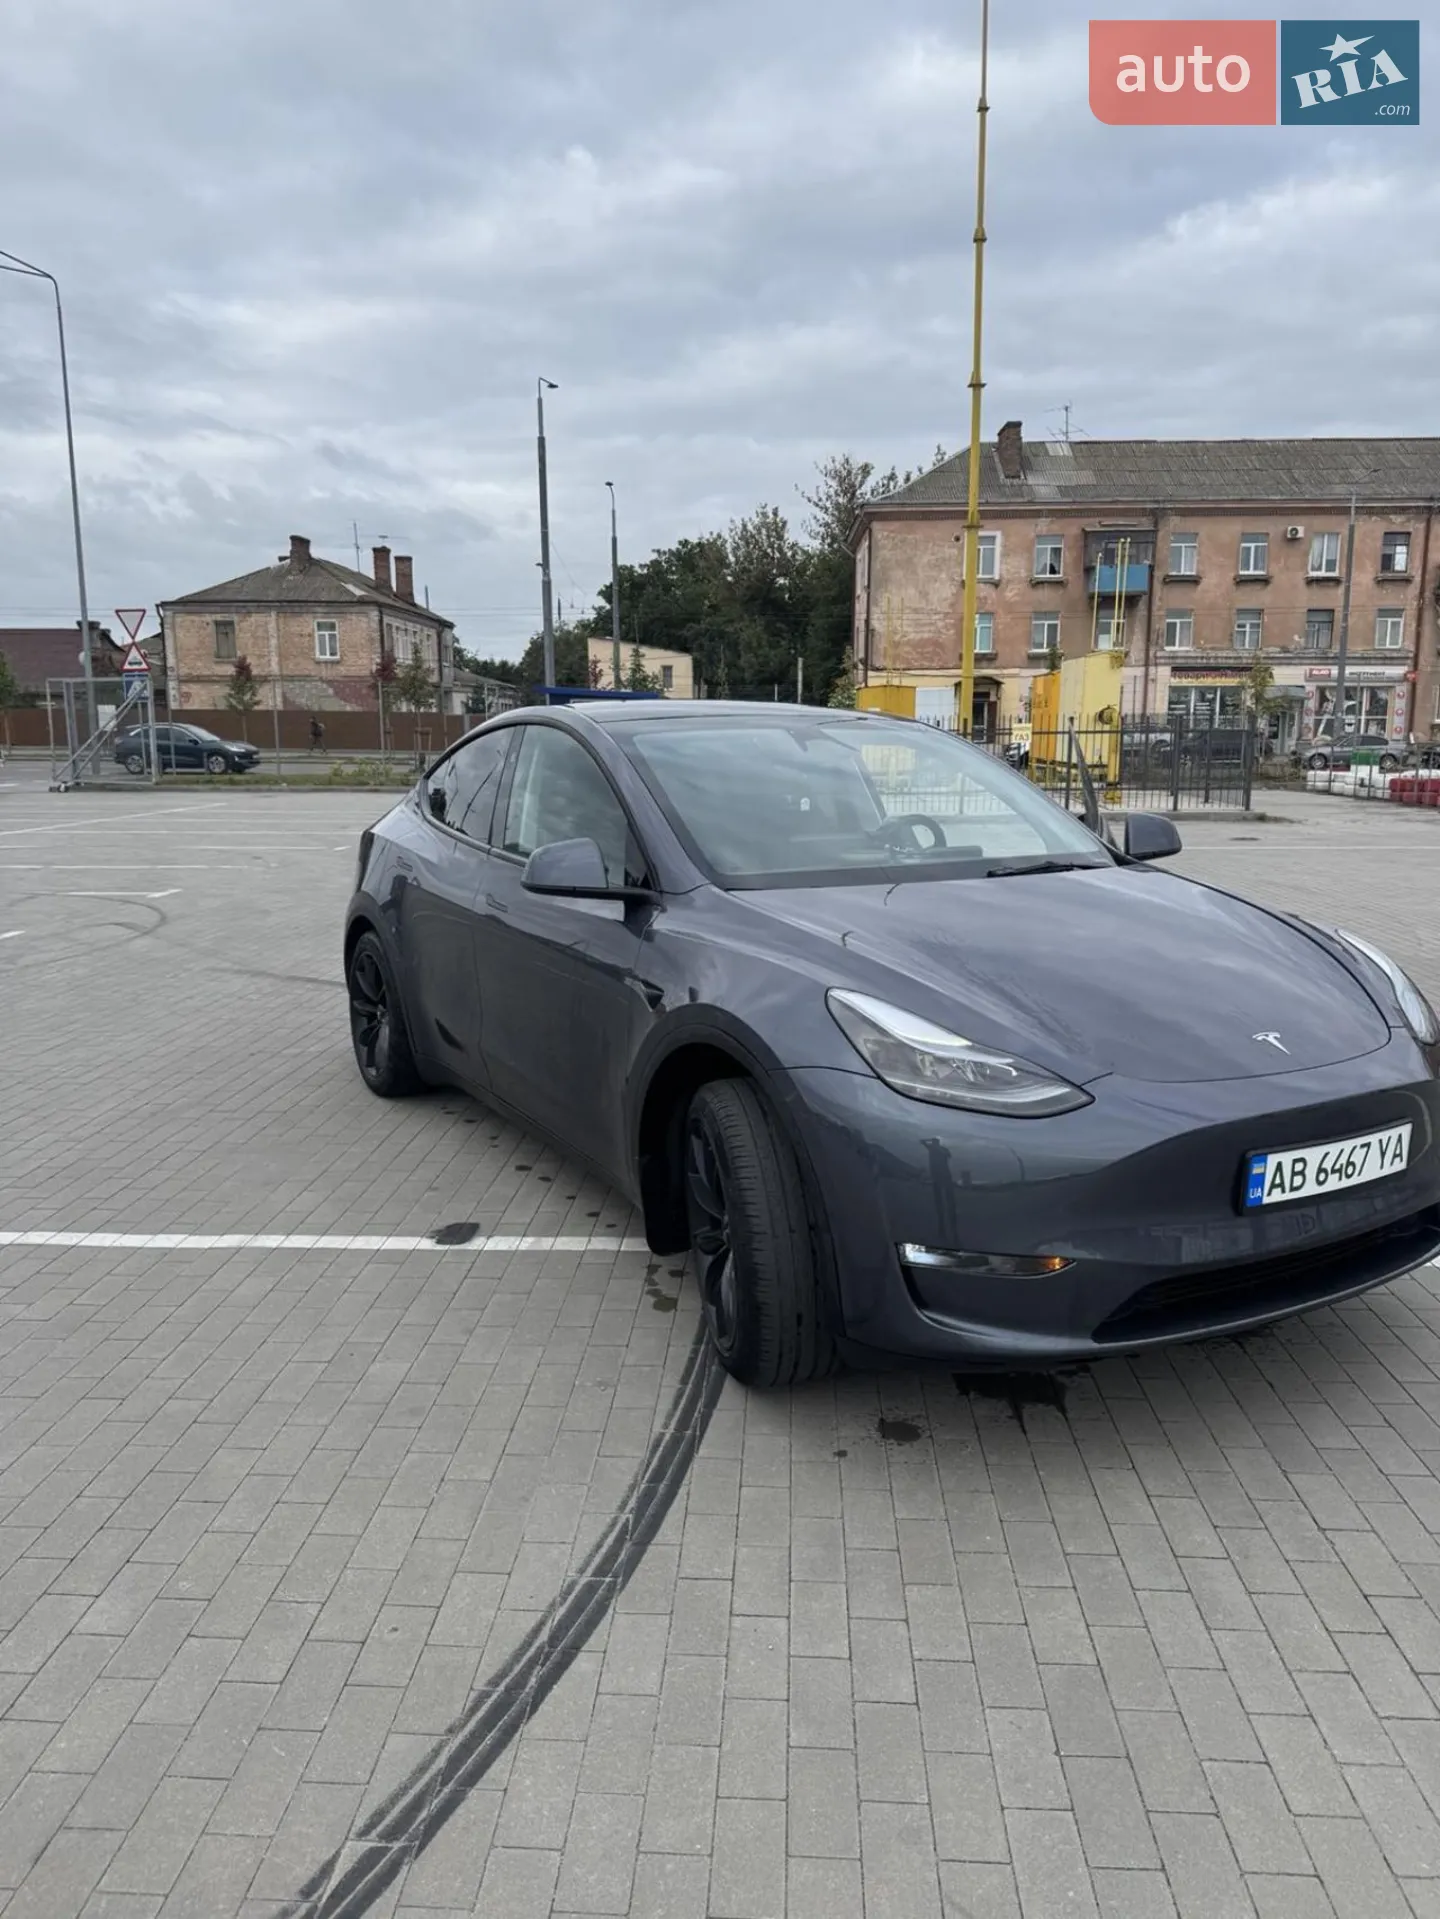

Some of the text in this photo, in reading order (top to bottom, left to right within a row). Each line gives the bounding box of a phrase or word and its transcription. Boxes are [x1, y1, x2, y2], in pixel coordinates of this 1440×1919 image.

[1267, 1133, 1403, 1197] AB 6467 YA
[1250, 1187, 1262, 1199] UA
